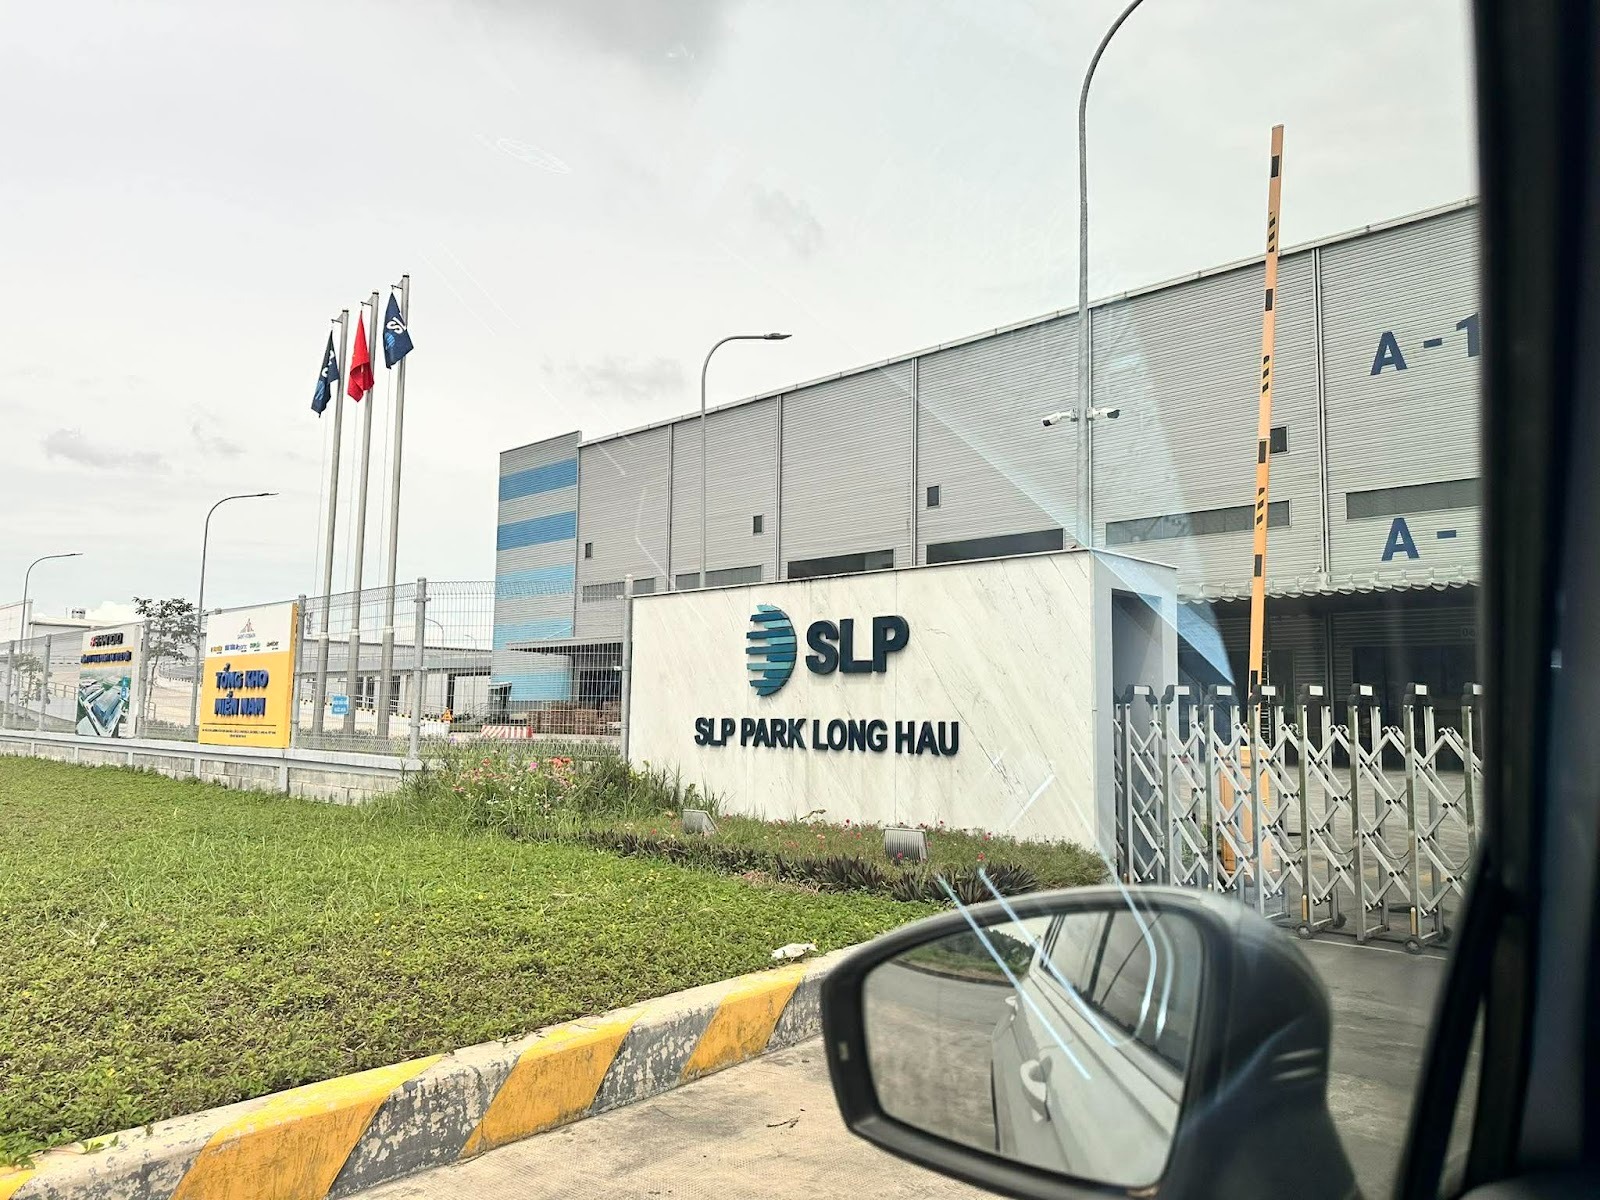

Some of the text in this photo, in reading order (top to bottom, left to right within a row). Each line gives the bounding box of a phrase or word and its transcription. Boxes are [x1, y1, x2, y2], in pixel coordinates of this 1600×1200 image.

[805, 615, 910, 676] SLP
[244, 670, 269, 689] KHO
[240, 697, 267, 716] NAM
[694, 717, 960, 757] SLP PARK LONG HAU
